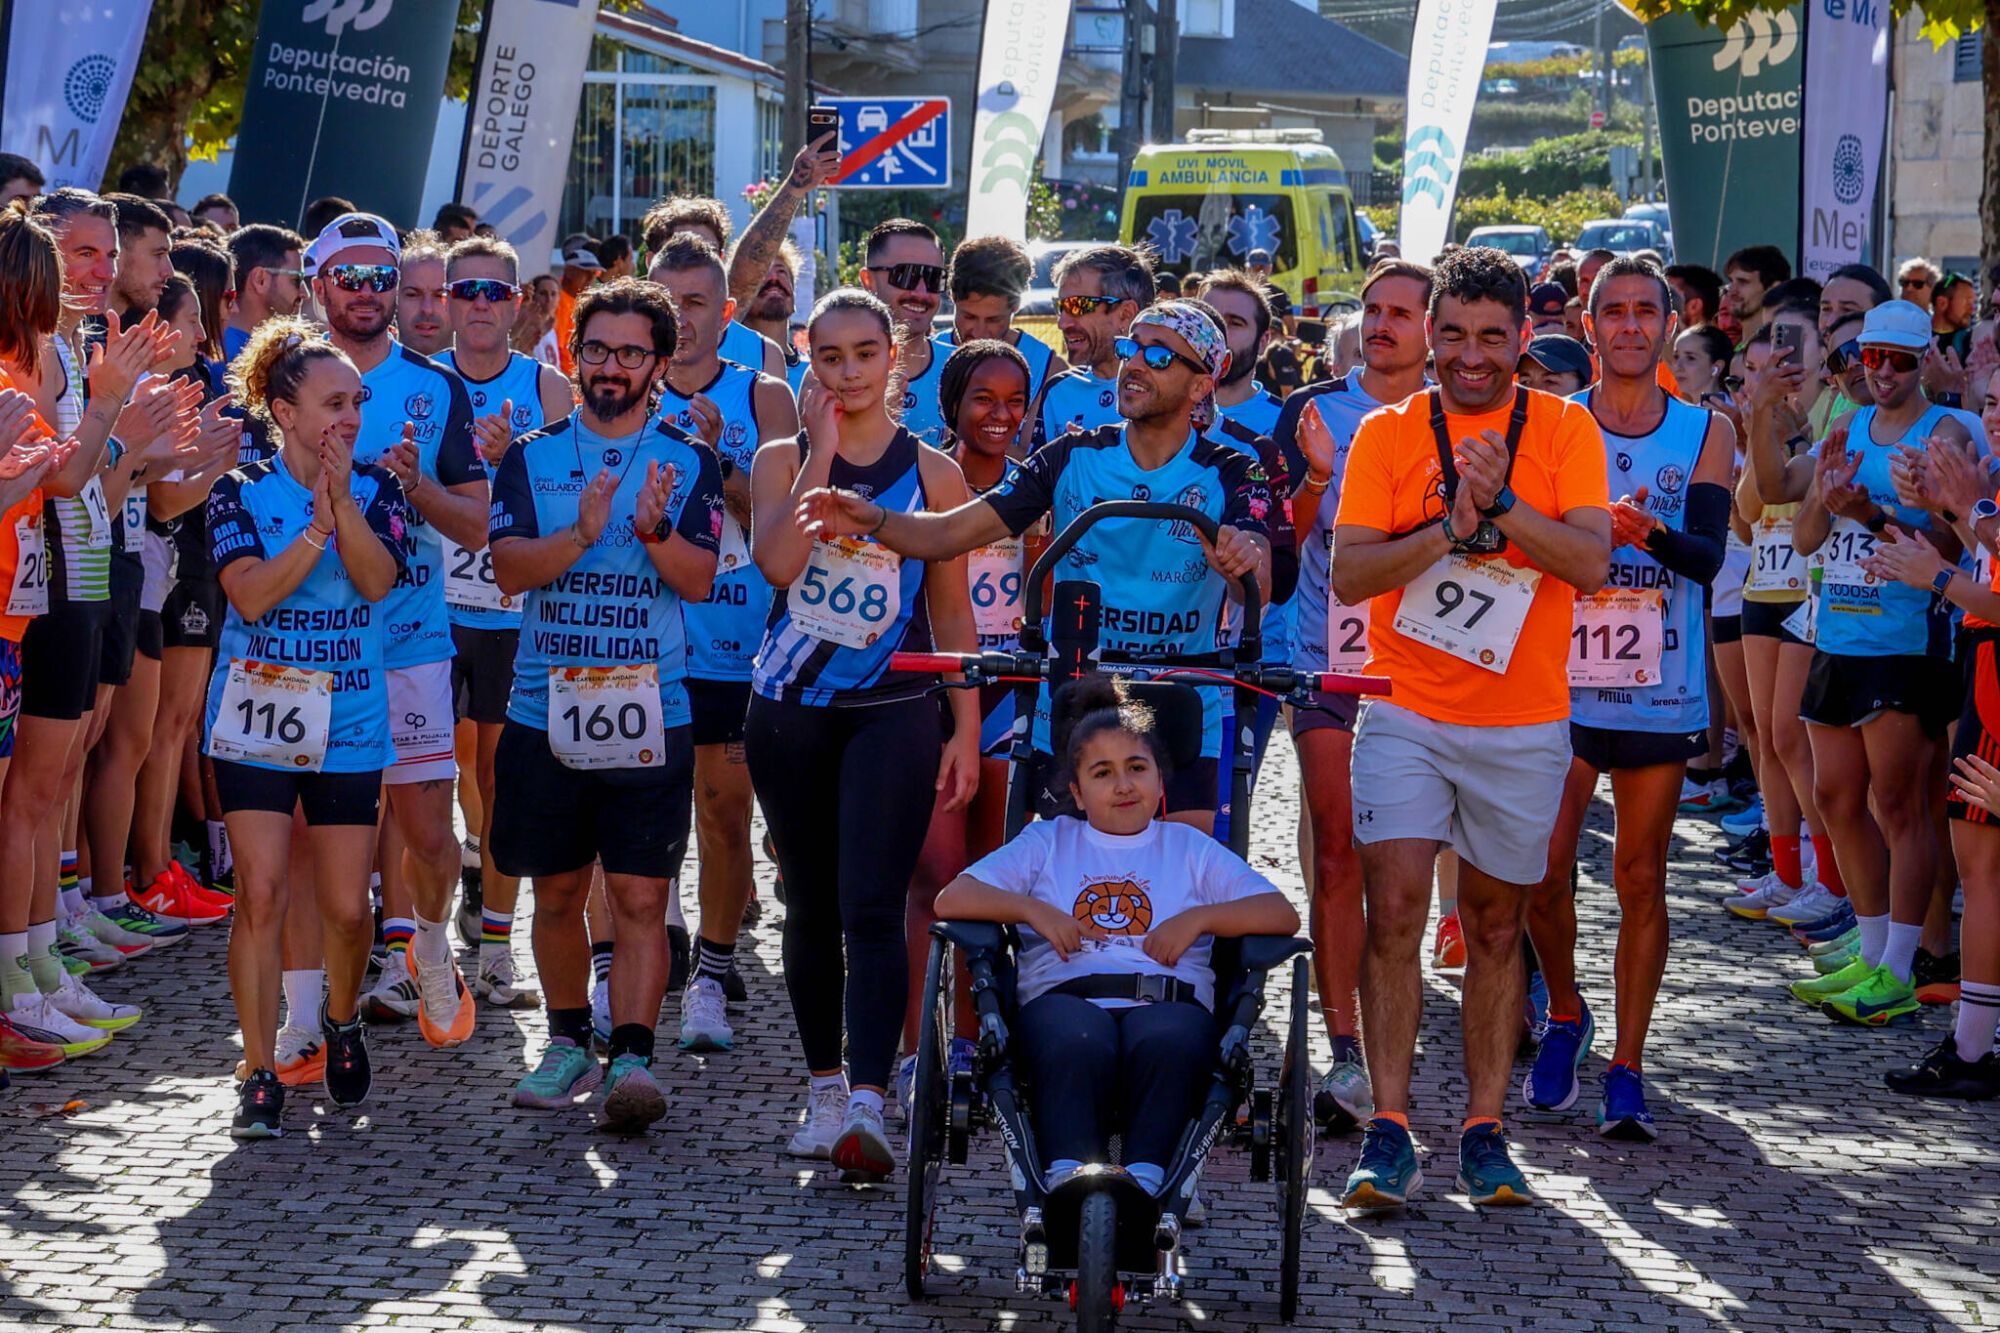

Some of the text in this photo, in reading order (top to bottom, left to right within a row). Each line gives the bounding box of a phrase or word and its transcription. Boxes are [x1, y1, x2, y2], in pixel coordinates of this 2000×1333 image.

[269, 42, 411, 83] Deputación
[264, 68, 406, 109] Pontevedra
[478, 45, 516, 169] DEPORTE
[501, 63, 536, 171] GALEGO
[1691, 116, 1802, 144] Ponteve
[1159, 170, 1270, 185] AMBULANCIA
[1177, 158, 1199, 169] UVI
[213, 520, 239, 543] BAR
[596, 535, 634, 548] RCOS
[1829, 531, 1877, 562] 313
[212, 533, 256, 562] PITILLO
[1758, 543, 1794, 571] 317
[800, 565, 888, 622] 568
[971, 571, 1022, 607] 69
[1435, 580, 1496, 629] 97
[243, 604, 370, 632] VERSIDAD
[246, 633, 361, 663] INCLUSIÓN
[534, 629, 660, 660] VISIBILIDAD
[1571, 624, 1641, 660] 112
[1597, 689, 1633, 704] PITILLO
[237, 698, 306, 744] 116
[562, 702, 647, 742] 160
